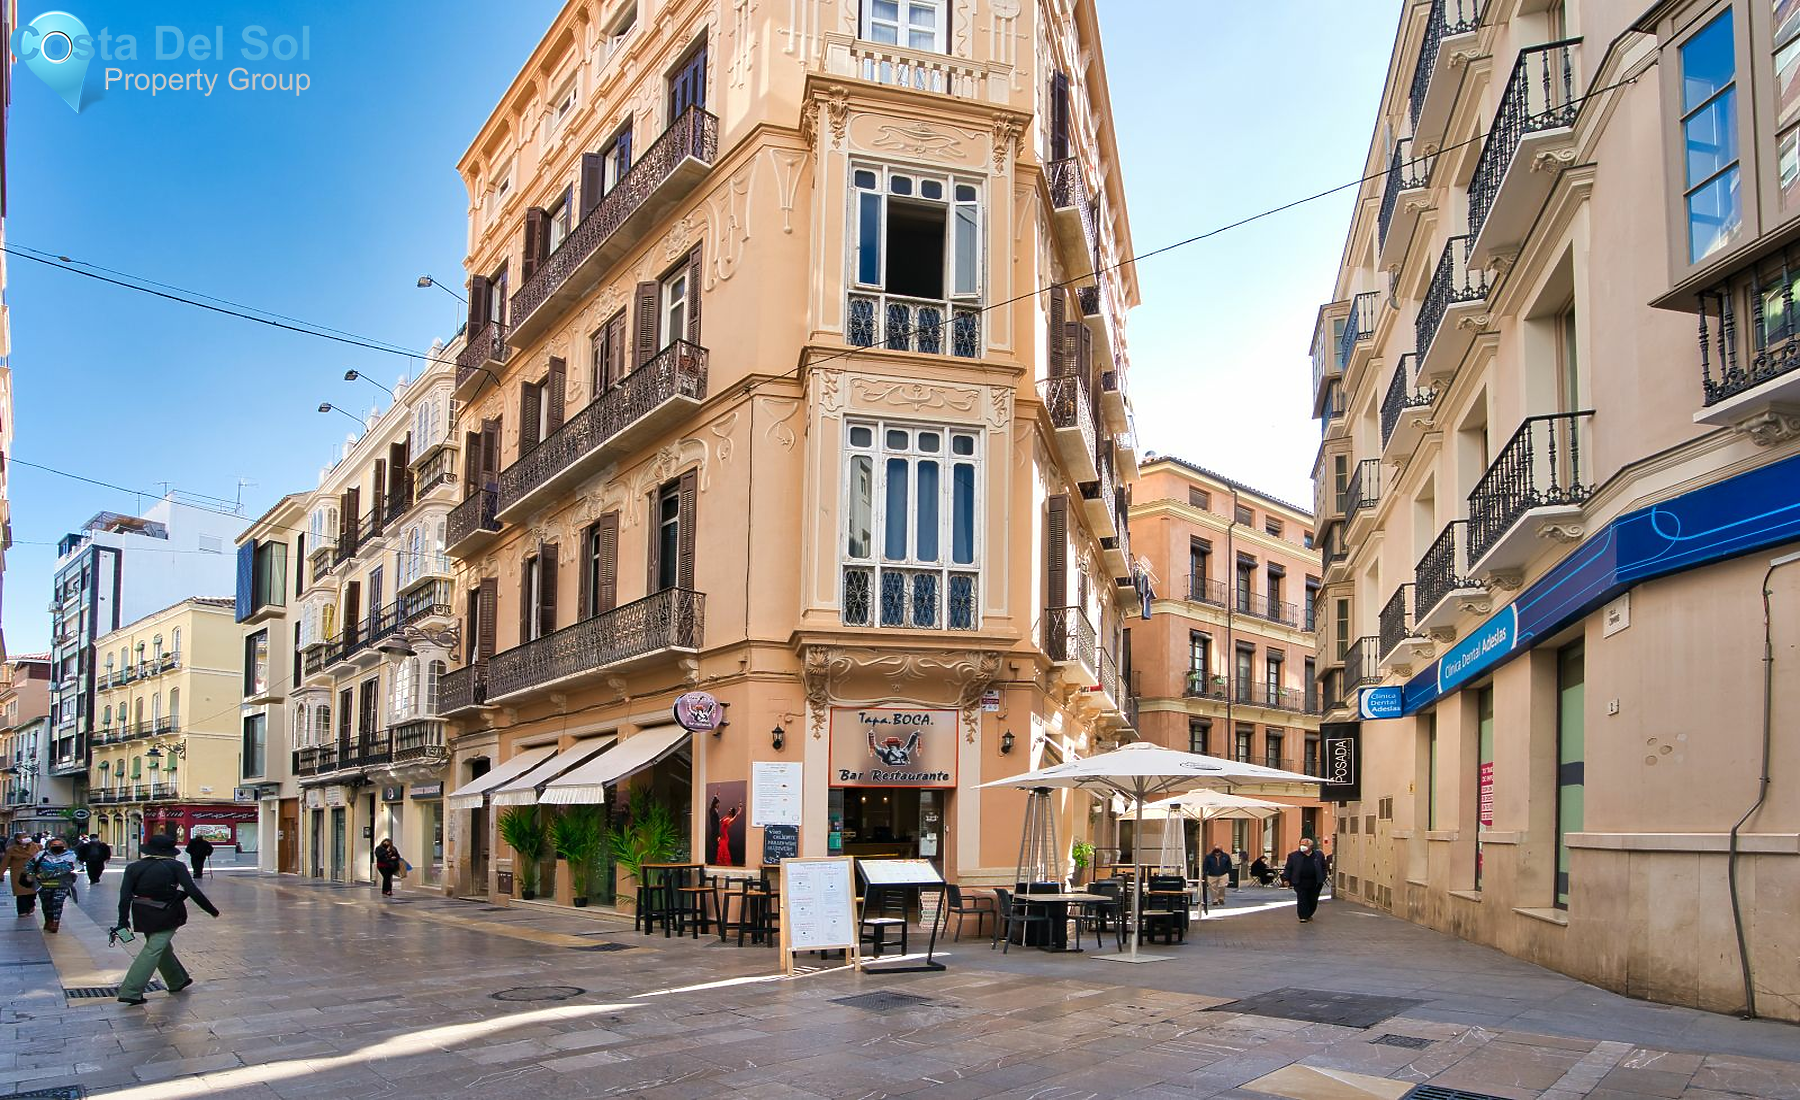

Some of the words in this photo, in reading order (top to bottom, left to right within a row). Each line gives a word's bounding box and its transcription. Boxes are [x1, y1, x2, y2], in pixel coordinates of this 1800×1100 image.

[1462, 641, 1481, 668] Dental
[1482, 627, 1506, 655] Adeslas
[839, 769, 865, 781] Bar
[870, 769, 950, 782] Restaurante
[1334, 740, 1348, 783] POSADA
